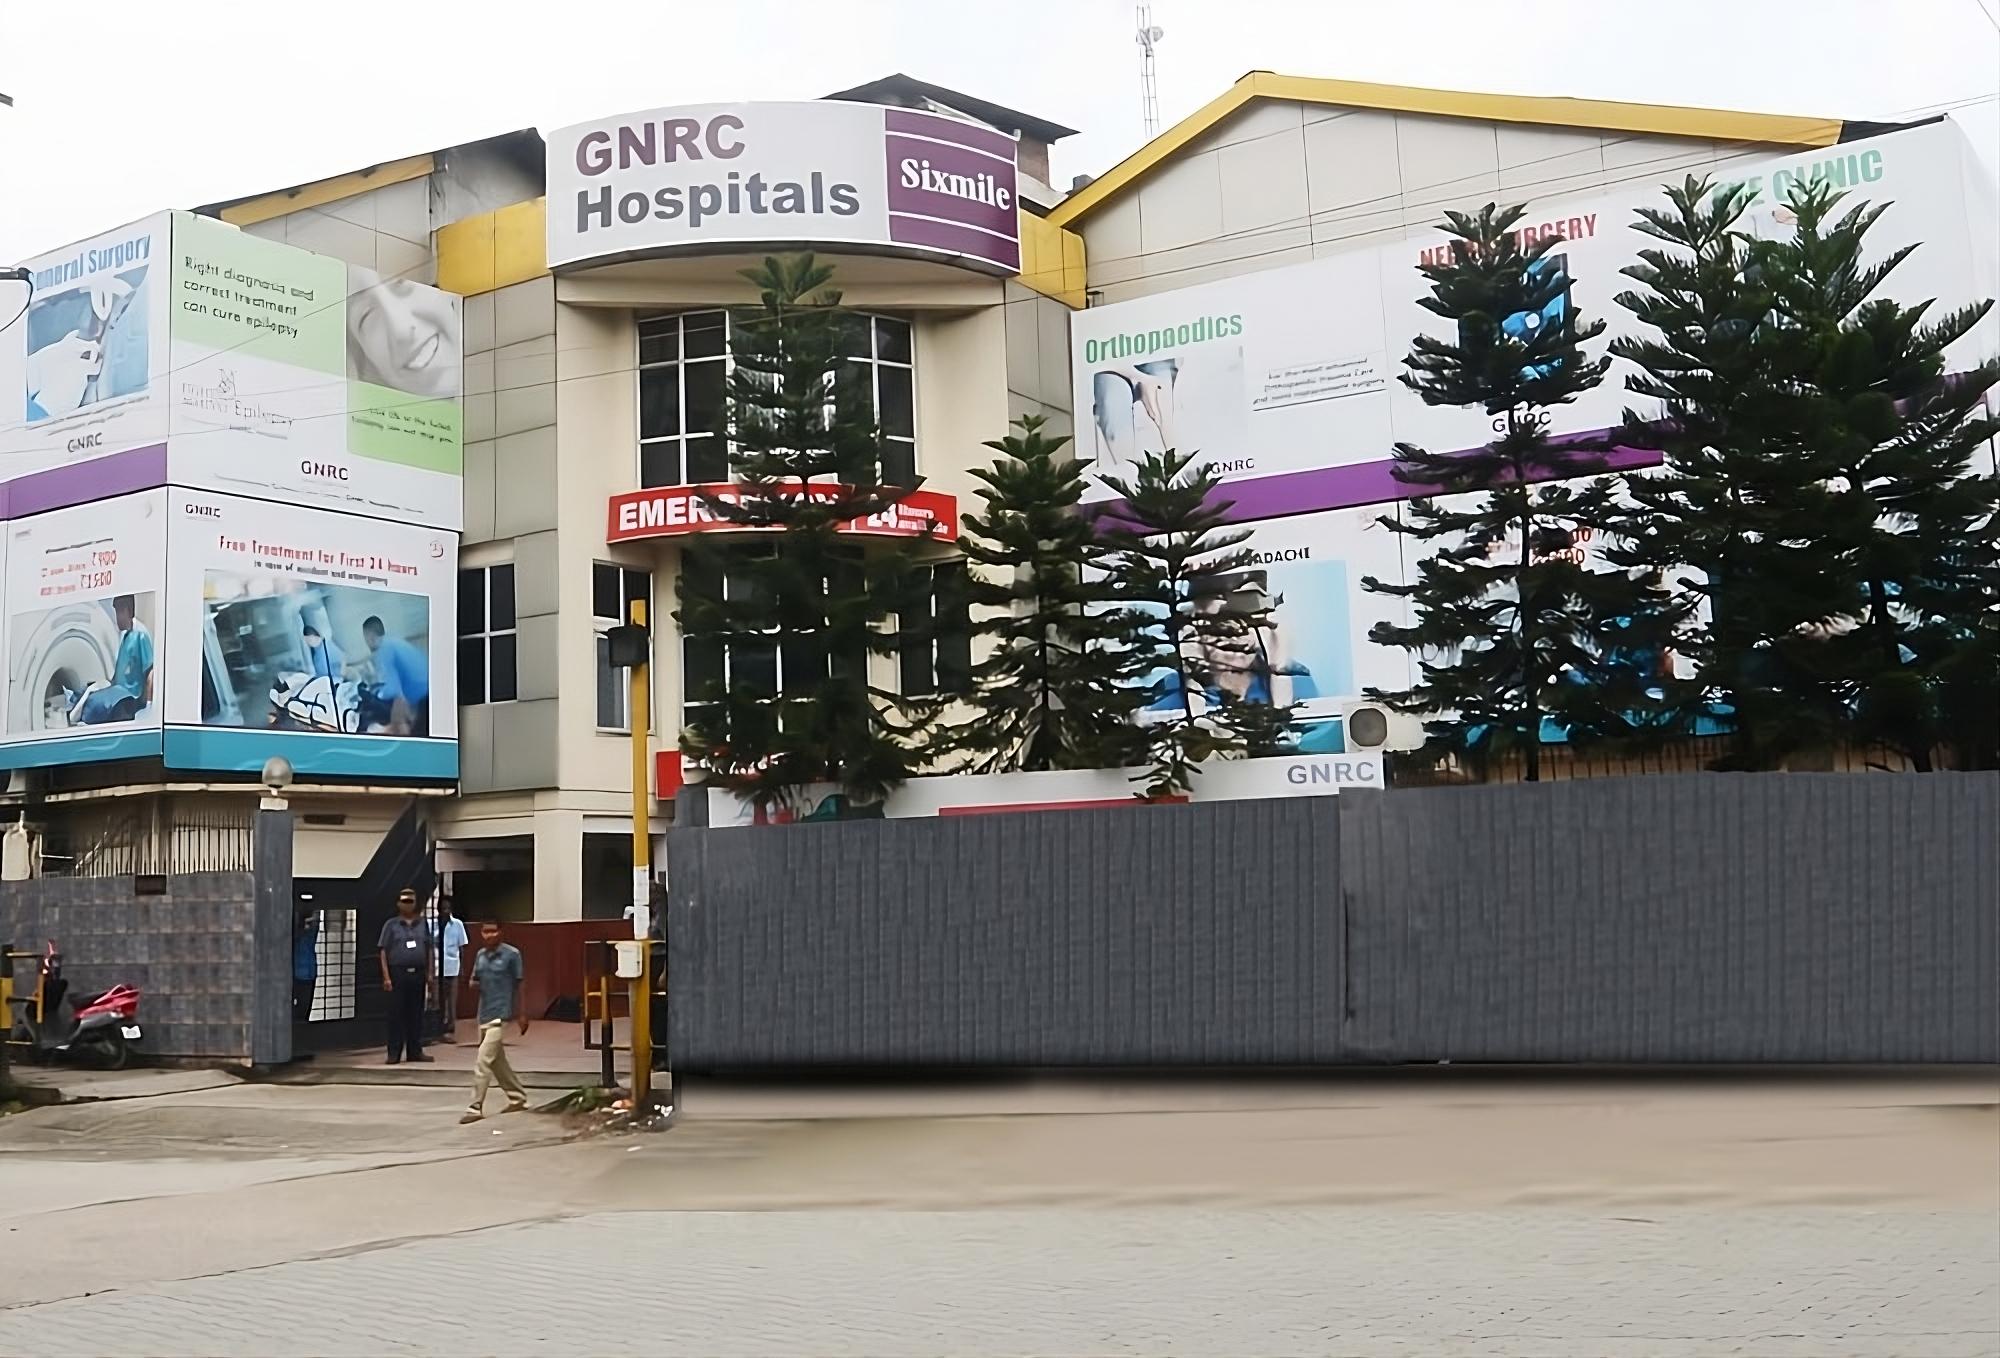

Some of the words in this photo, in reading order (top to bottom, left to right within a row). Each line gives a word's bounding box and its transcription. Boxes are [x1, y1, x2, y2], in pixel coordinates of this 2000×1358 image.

[576, 114, 746, 177] GNRC
[900, 157, 1011, 211] Sixmile
[577, 171, 860, 234] Hospitals
[67, 432, 104, 454] GNRC
[301, 460, 349, 481] GNRC
[1211, 457, 1255, 475] GNRC
[1287, 761, 1375, 784] GNRC
